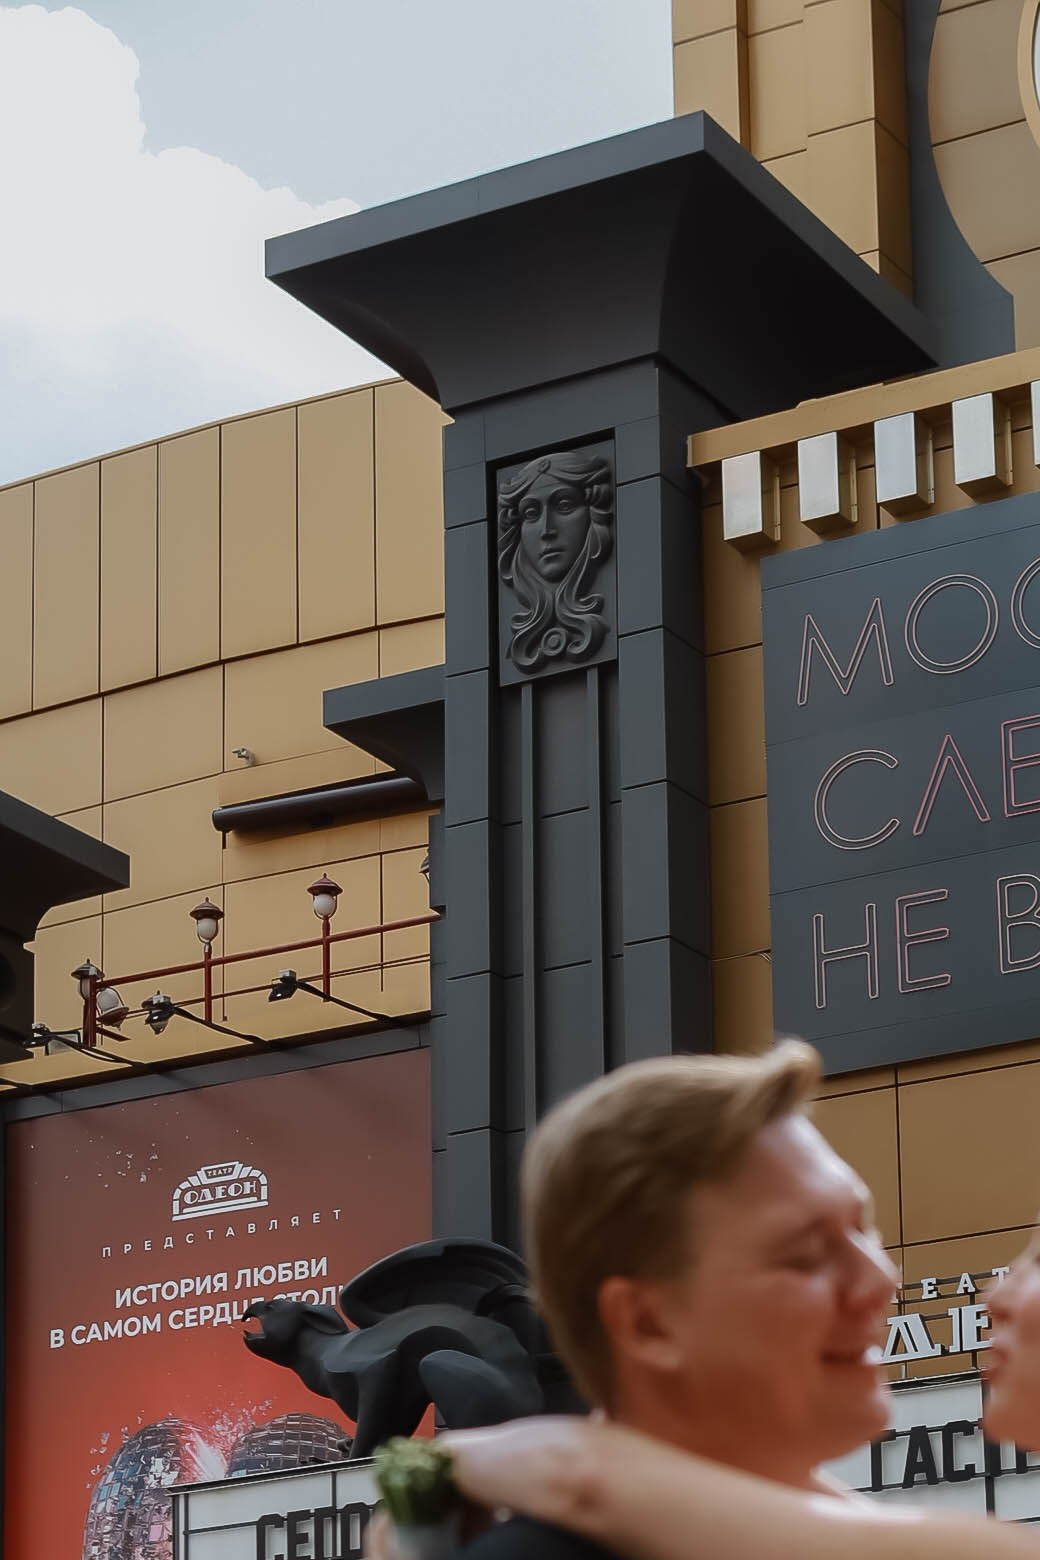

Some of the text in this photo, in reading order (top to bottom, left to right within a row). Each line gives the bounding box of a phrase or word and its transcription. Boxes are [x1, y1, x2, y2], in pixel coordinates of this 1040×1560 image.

[813, 889, 951, 1009] НЕ
[184, 1180, 257, 1205] ОДЕОН
[207, 1167, 233, 1177] ТЕАТР
[102, 1209, 342, 1258] ПРЕДСТАВЛЯЕТ
[114, 1256, 328, 1310] ИСТОРИЯ ЛЮБВИ
[49, 1329, 65, 1349] В
[71, 1313, 162, 1344] САМОМ
